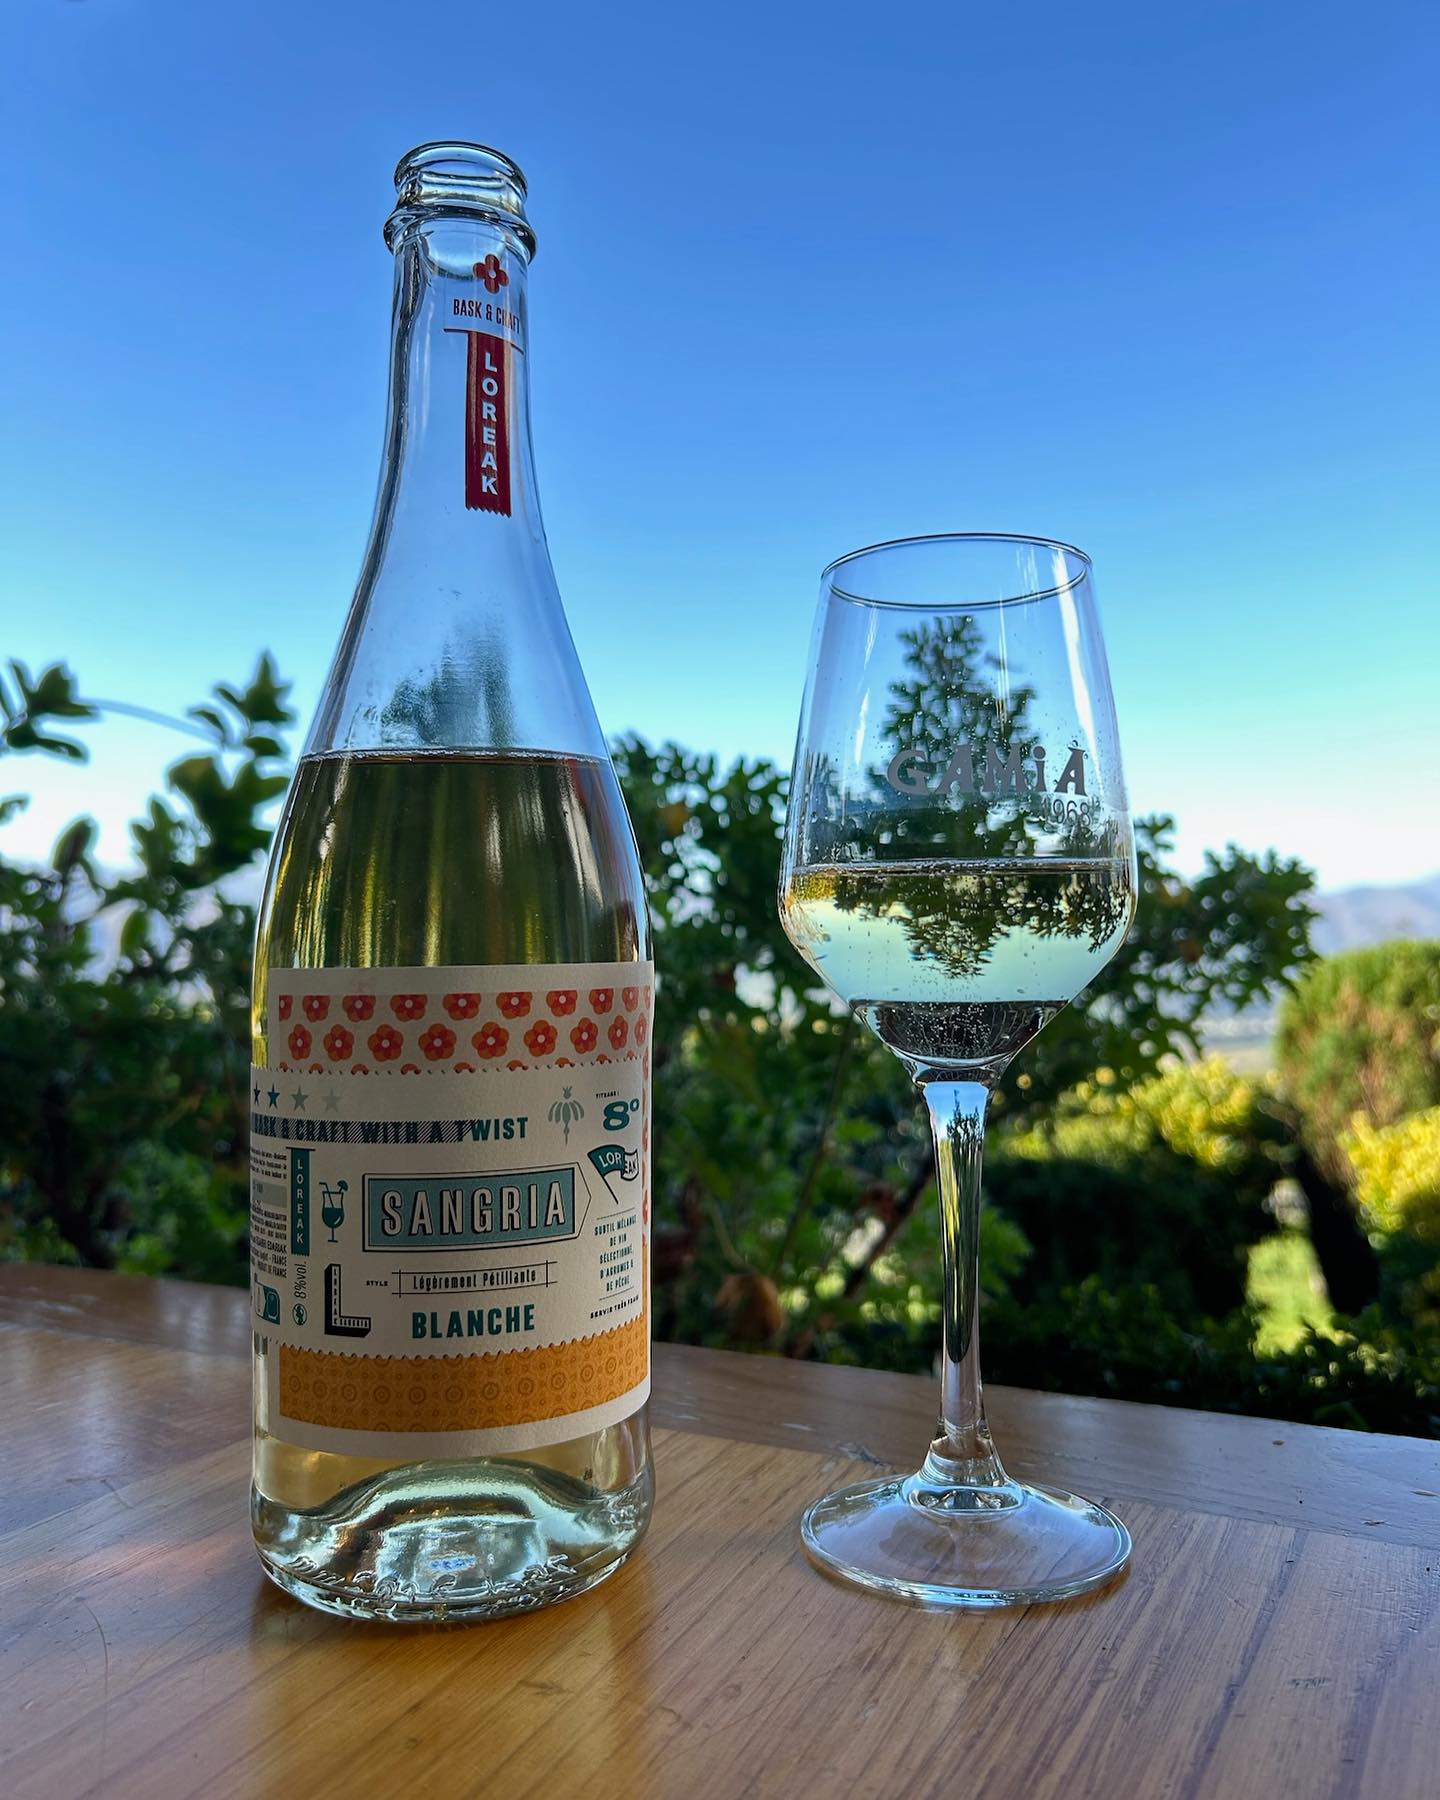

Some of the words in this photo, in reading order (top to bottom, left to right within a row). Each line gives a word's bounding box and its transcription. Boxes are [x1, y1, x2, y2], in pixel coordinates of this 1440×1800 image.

[453, 298, 482, 319] BASK
[486, 303, 492, 321] &
[482, 351, 498, 496] LOREAK
[361, 1120, 417, 1143] WITH
[428, 1120, 444, 1142] A
[455, 1117, 529, 1142] TWIST
[296, 1158, 304, 1244] LOREAK
[381, 1180, 566, 1237] SANGRIA
[413, 1273, 477, 1291] Légèrement
[483, 1268, 536, 1287] Pétillante
[412, 1303, 536, 1339] BLANCHE
